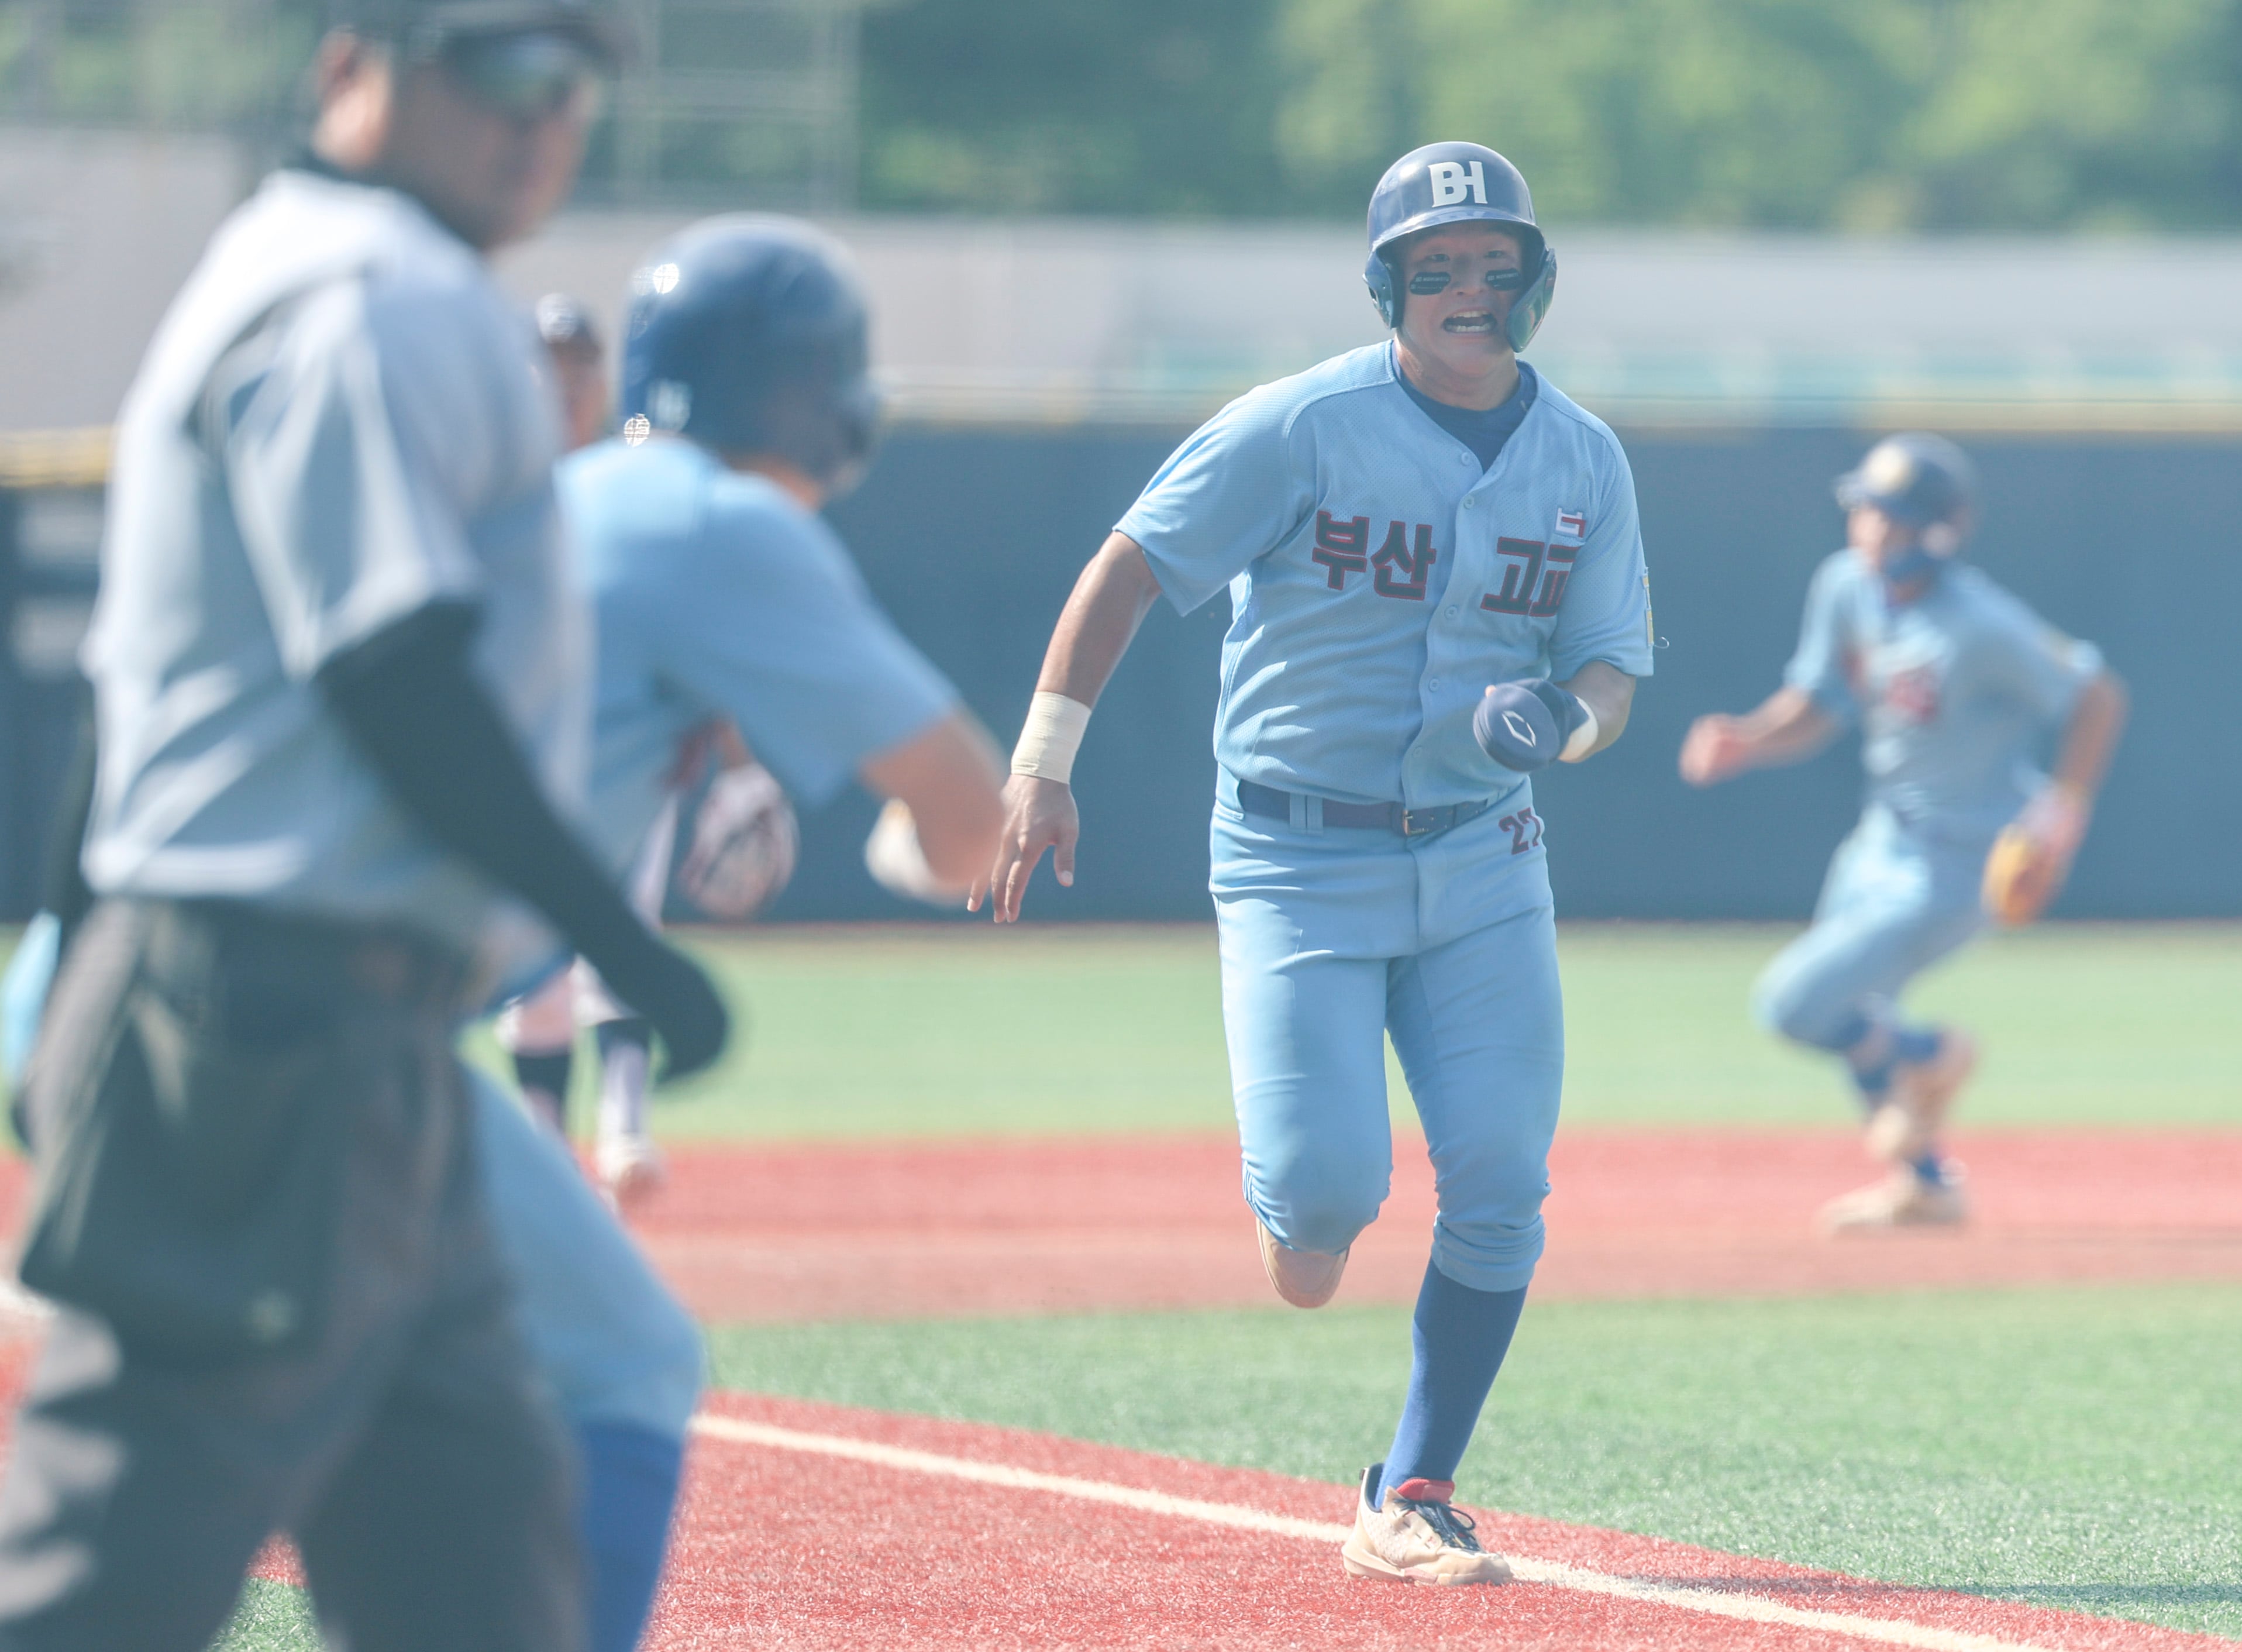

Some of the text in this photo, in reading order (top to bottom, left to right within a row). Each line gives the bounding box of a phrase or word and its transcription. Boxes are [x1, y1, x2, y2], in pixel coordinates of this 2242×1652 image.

[1427, 161, 1488, 208] BH
[1312, 510, 1437, 601] 부산
[1499, 807, 1541, 855] 27
